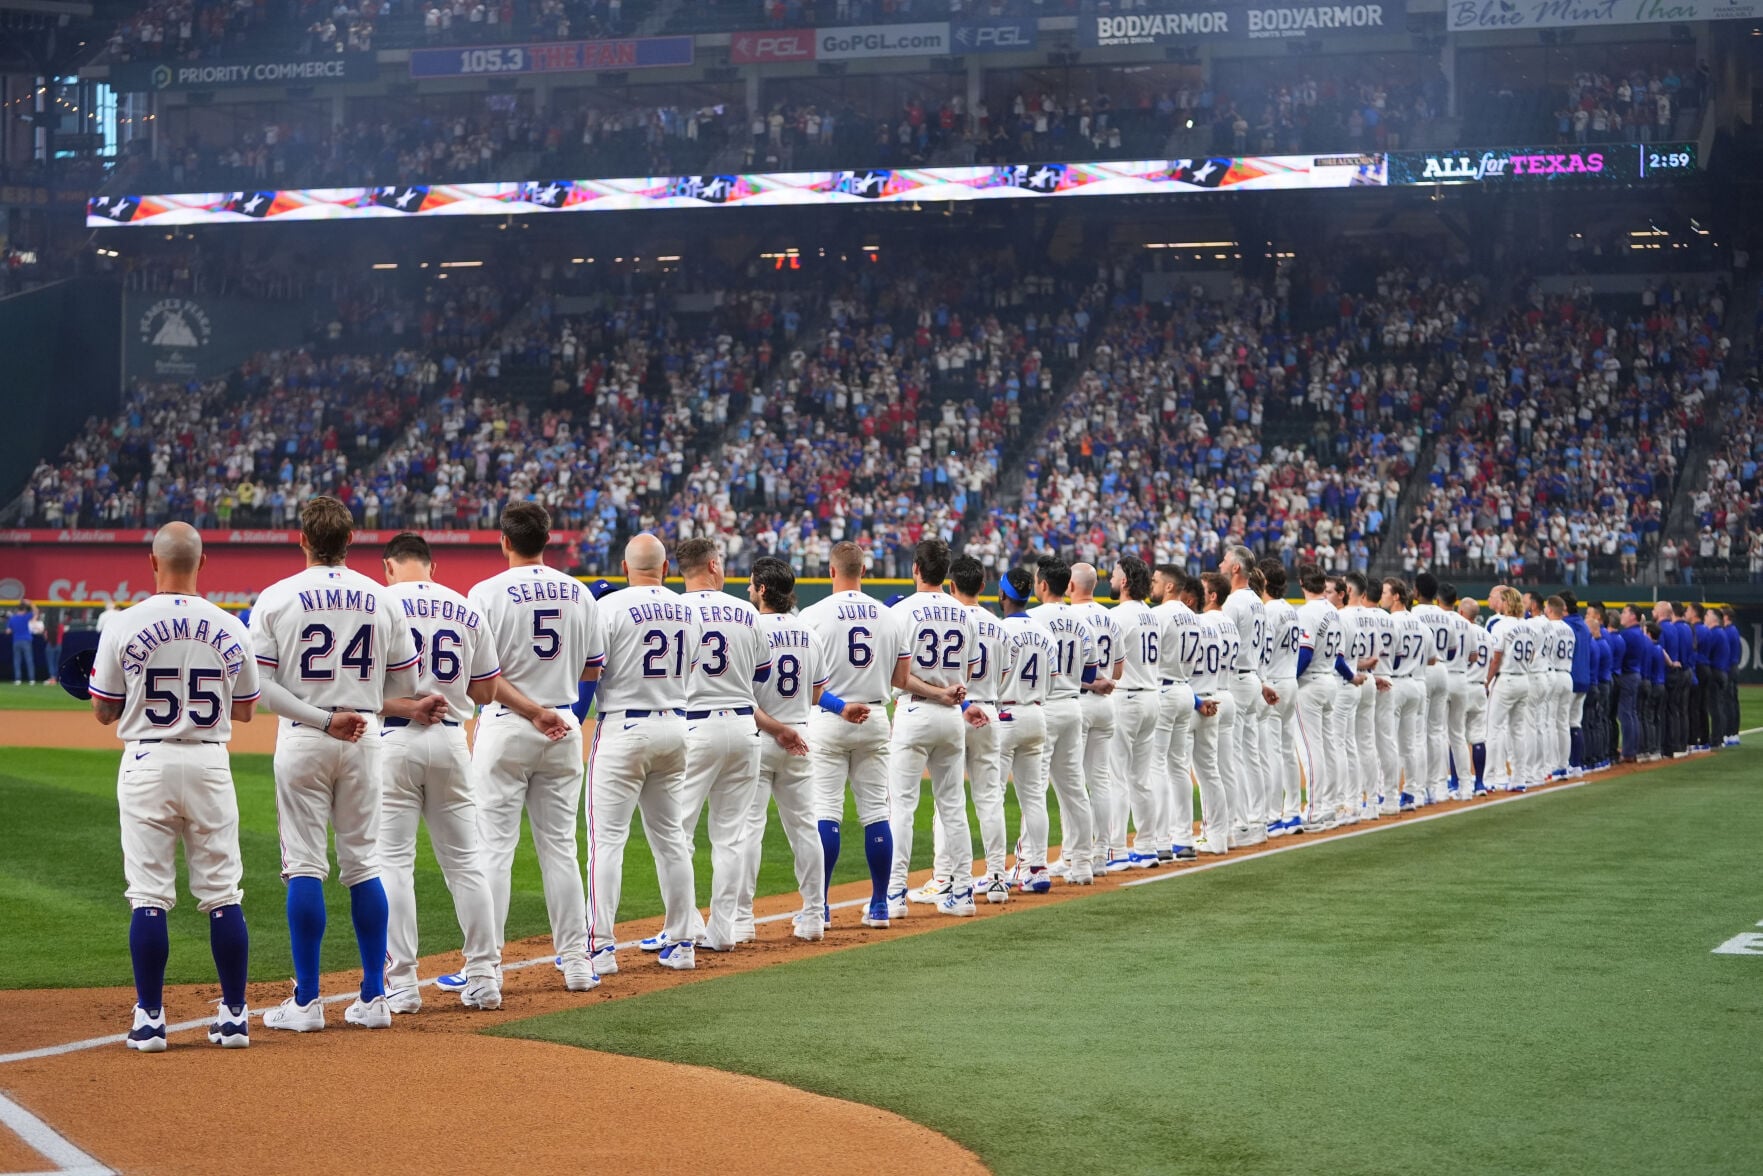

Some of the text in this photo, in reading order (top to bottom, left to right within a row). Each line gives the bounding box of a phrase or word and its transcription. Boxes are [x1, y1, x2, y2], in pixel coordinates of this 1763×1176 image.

[1097, 12, 1229, 37] BODYARMOR
[1247, 5, 1383, 30] BODYARMOR
[1451, 0, 1525, 27] Blue
[755, 37, 808, 57] PGL
[823, 33, 942, 52] GoPGL.com
[976, 26, 1030, 46] PGL
[461, 42, 636, 72] 105.3 THE FAN
[178, 60, 344, 83] PRIORITY COMMERCE
[1422, 152, 1604, 180] ALL for TEXAS
[1649, 152, 1690, 168] 2:59
[299, 588, 376, 615] NIMMO
[507, 581, 580, 605] SEAGER
[401, 598, 480, 631] NGFORD
[628, 602, 692, 625] BURGER
[701, 605, 753, 628] ERSON
[838, 604, 878, 621] JUNG
[913, 605, 967, 625] CARTER
[123, 617, 244, 677] SCHUMAKER
[532, 609, 562, 661] 5
[848, 626, 873, 668] 6
[916, 628, 965, 669] 32
[1141, 631, 1158, 664] 16
[1181, 631, 1199, 662] 17
[1281, 626, 1300, 653] 48
[1324, 631, 1342, 658] 52
[1430, 627, 1448, 651] 0
[300, 623, 375, 681] 24
[643, 629, 686, 678] 21
[701, 630, 729, 677] 3
[1057, 639, 1075, 676] 11
[1098, 634, 1111, 668] 3
[1193, 644, 1219, 674] 20
[1514, 640, 1533, 661] 96
[777, 654, 801, 698] 8
[1021, 653, 1038, 689] 4
[144, 668, 224, 728] 55
